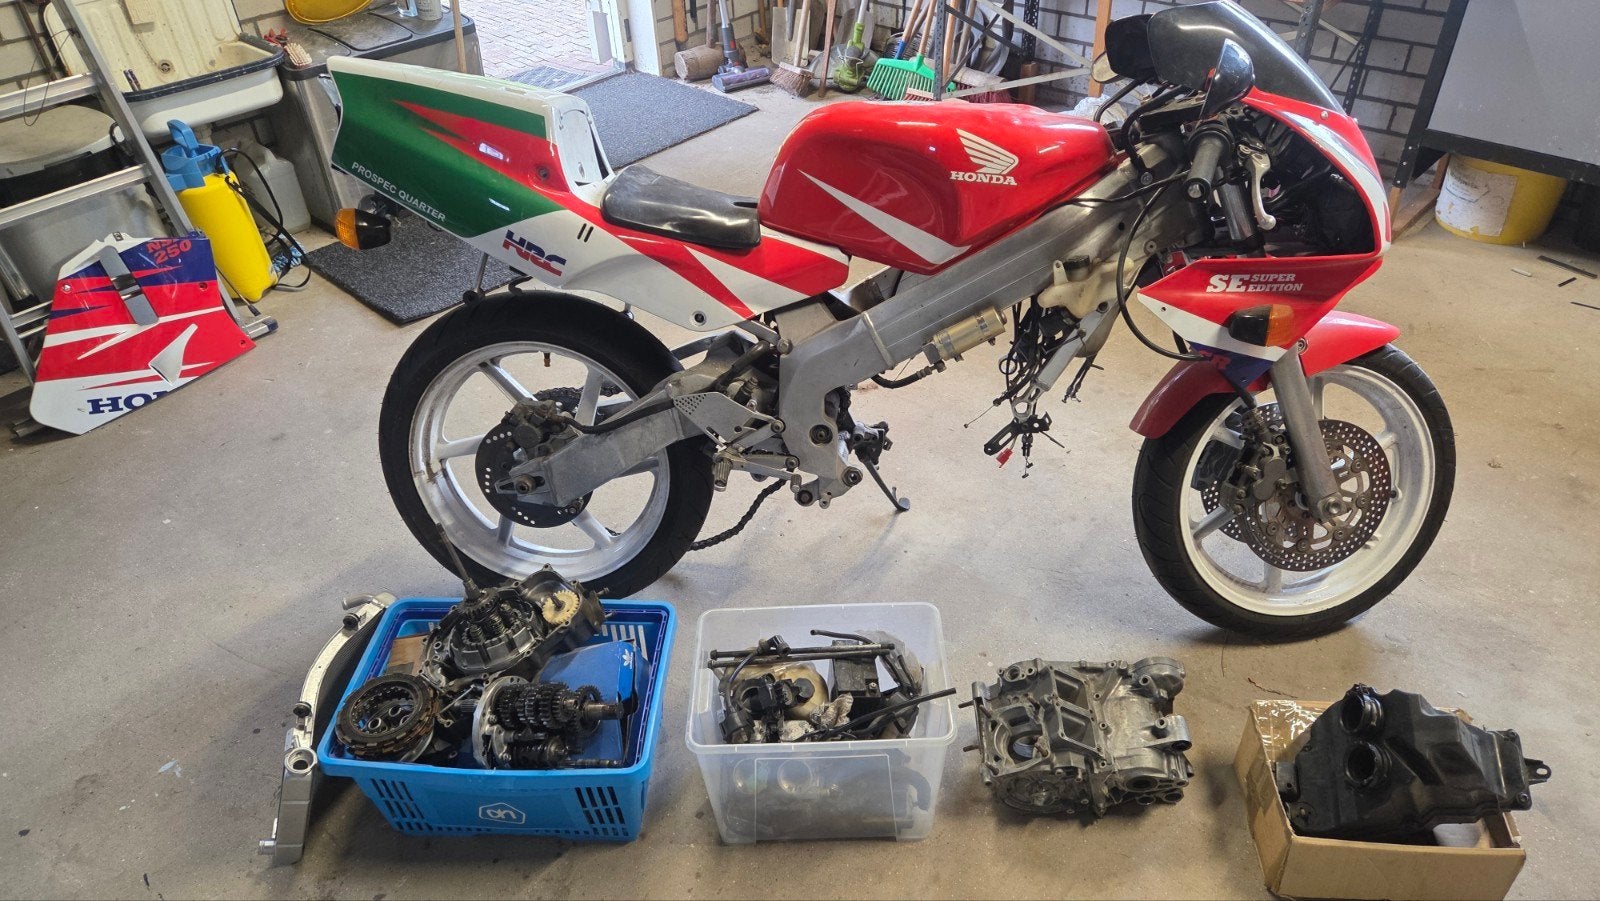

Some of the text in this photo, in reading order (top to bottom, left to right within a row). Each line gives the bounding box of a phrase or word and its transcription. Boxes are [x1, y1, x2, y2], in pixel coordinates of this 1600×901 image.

[949, 170, 1018, 186] HONDA
[351, 161, 447, 222] PROSPEC QUARTER
[154, 239, 192, 265] 250
[502, 229, 567, 277] HRC
[1205, 273, 1251, 293] SE
[1246, 283, 1304, 292] EDITION
[1250, 273, 1296, 282] SUPER
